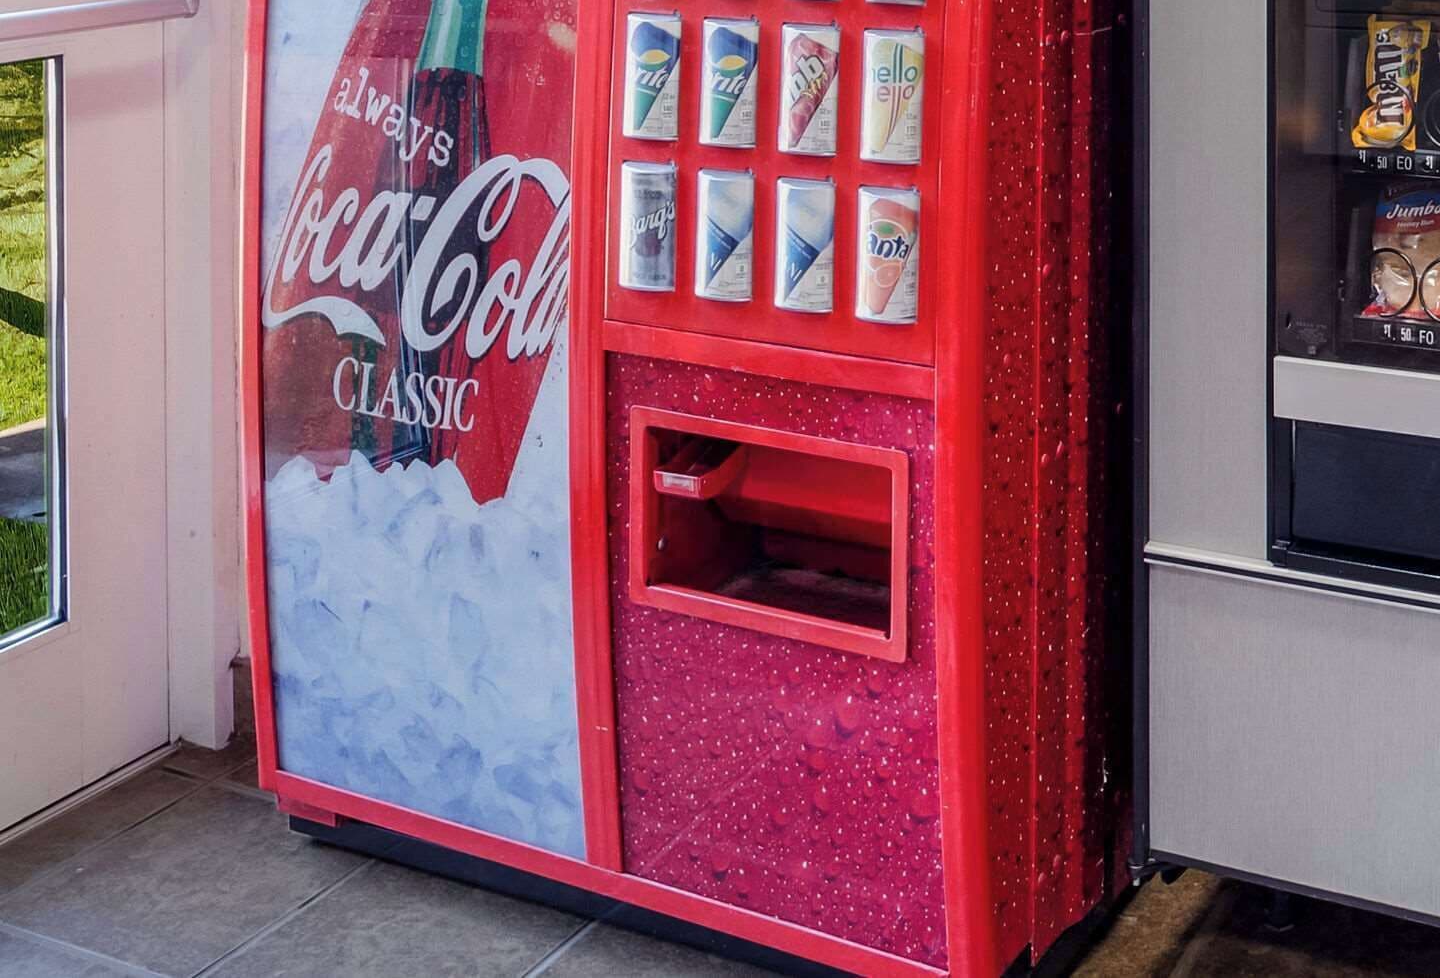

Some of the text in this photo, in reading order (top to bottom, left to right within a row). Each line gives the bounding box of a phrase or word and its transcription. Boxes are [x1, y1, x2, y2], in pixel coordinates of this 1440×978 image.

[334, 67, 454, 168] always
[1397, 156, 1412, 170] E0
[1419, 330, 1434, 344] F0
[333, 357, 479, 432] CLASSIC
